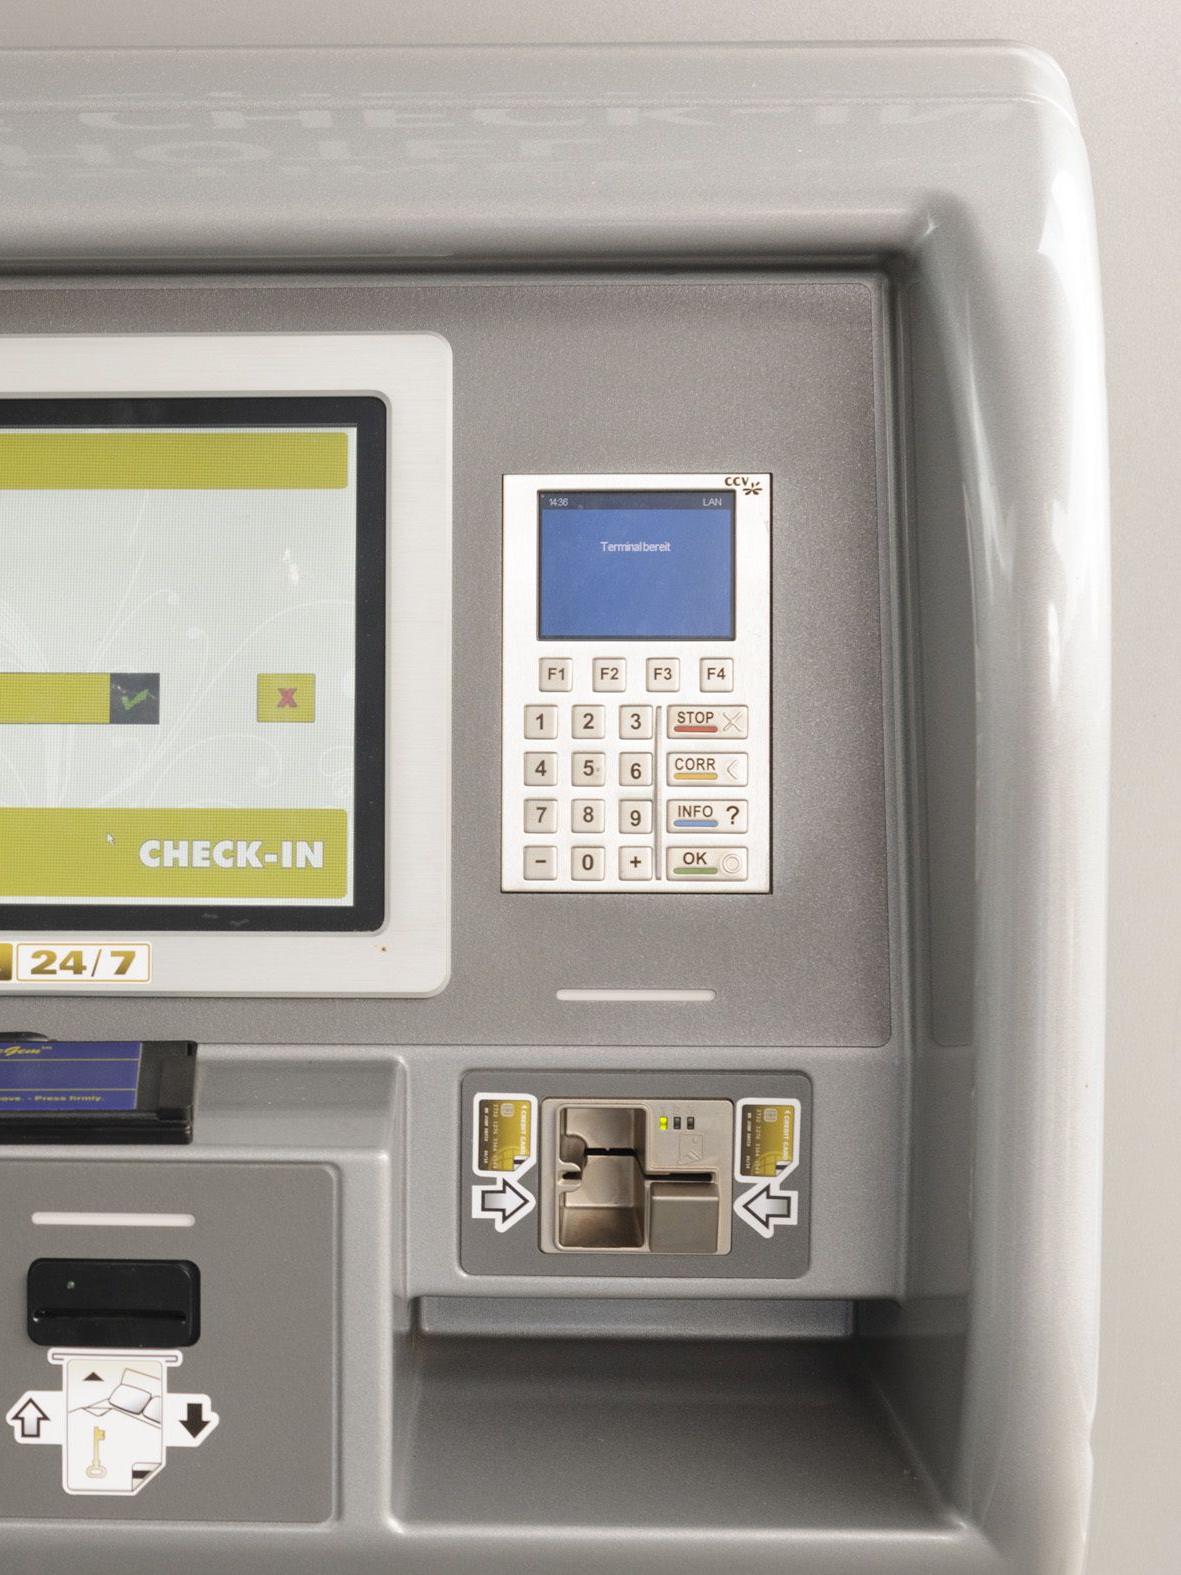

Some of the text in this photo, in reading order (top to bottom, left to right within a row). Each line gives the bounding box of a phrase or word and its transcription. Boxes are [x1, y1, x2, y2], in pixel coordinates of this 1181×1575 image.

[724, 476, 749, 487] CCV
[702, 497, 722, 507] LAN
[600, 541, 671, 552] Terminal bereit
[547, 668, 566, 681] F1
[600, 668, 619, 681] F2
[653, 668, 672, 681] F3
[706, 668, 726, 681] F4
[535, 713, 545, 730] 1
[582, 713, 595, 730] 2
[630, 713, 641, 730] 3
[677, 711, 714, 724] STOP
[534, 760, 547, 776] 4
[582, 760, 594, 776] 5
[630, 763, 642, 780] 6
[674, 758, 716, 771] CORR
[535, 807, 547, 823] 7
[582, 806, 594, 823] 8
[630, 810, 641, 827] 9
[677, 805, 714, 818] INFO
[138, 838, 325, 869] CHECK-IN
[683, 852, 708, 865] OK
[582, 854, 594, 871] 0
[29, 949, 137, 978] 24/7
